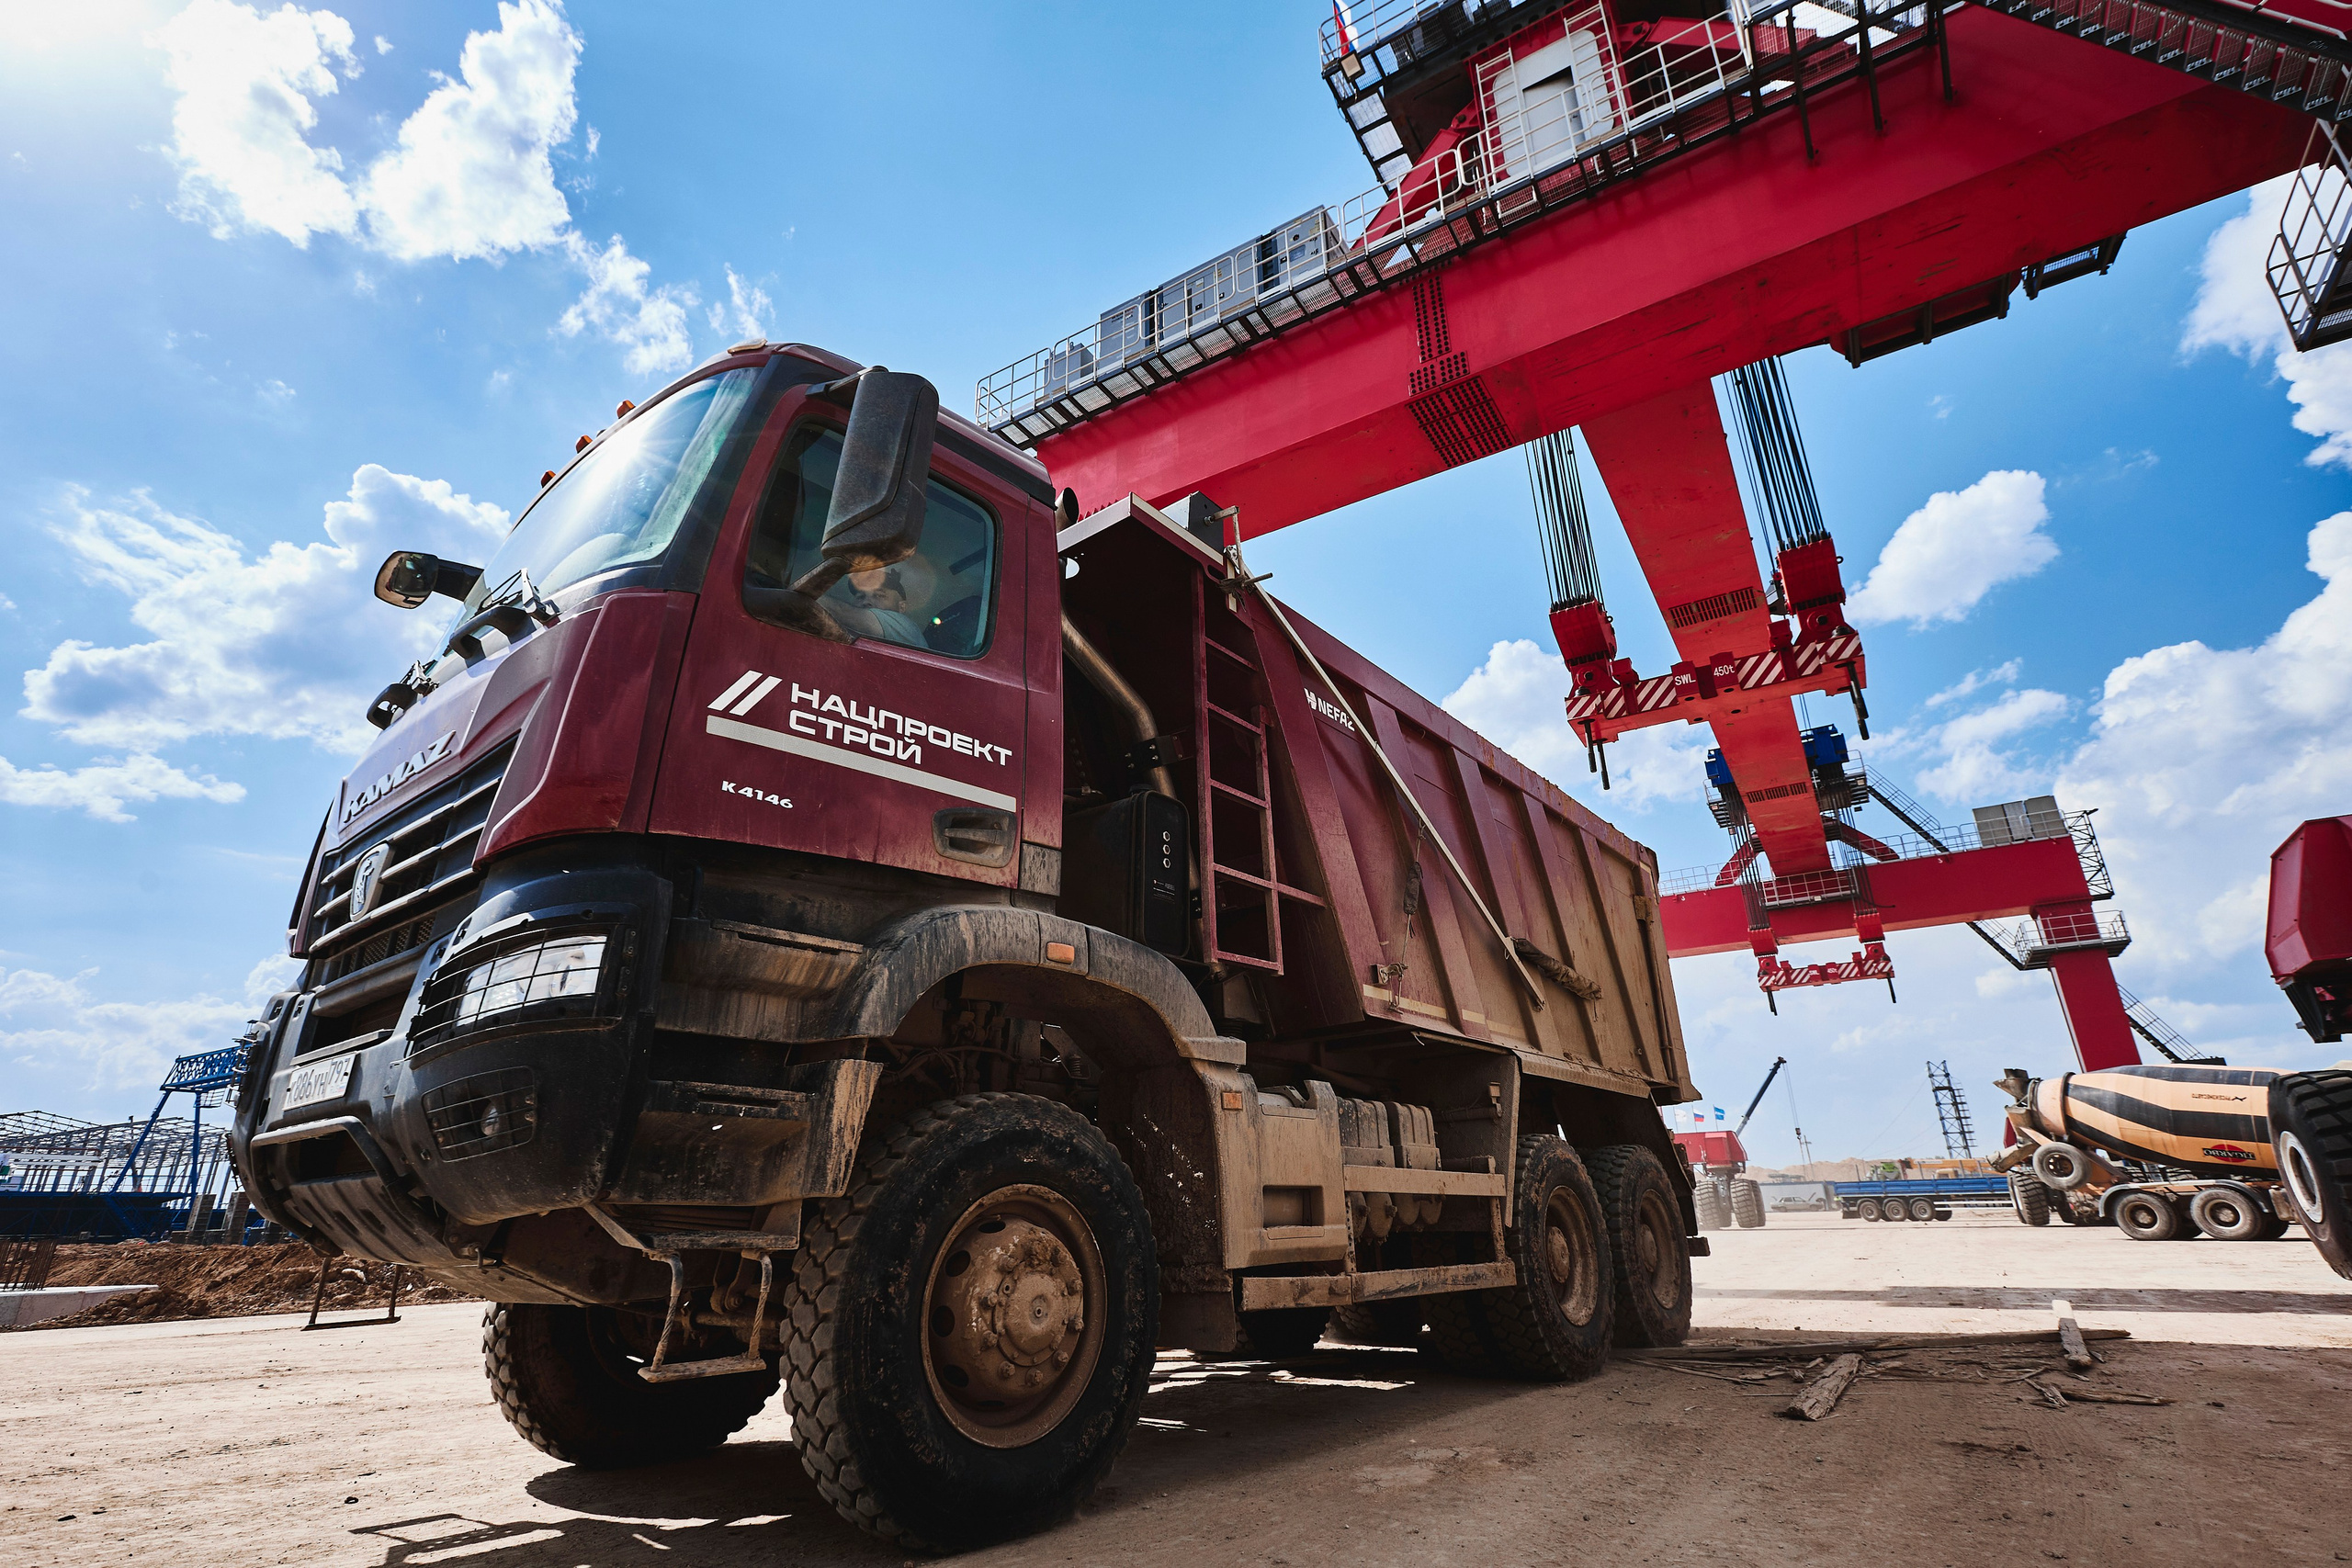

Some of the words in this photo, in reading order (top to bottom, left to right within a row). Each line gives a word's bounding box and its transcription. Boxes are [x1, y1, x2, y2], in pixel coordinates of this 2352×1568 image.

[1674, 673, 1697, 686] SWL
[1713, 664, 1735, 677] 450t
[788, 710, 922, 764] СТРОЙ
[790, 682, 1012, 766] НАЦПРОЕКТ
[344, 730, 457, 824] KAMAZ
